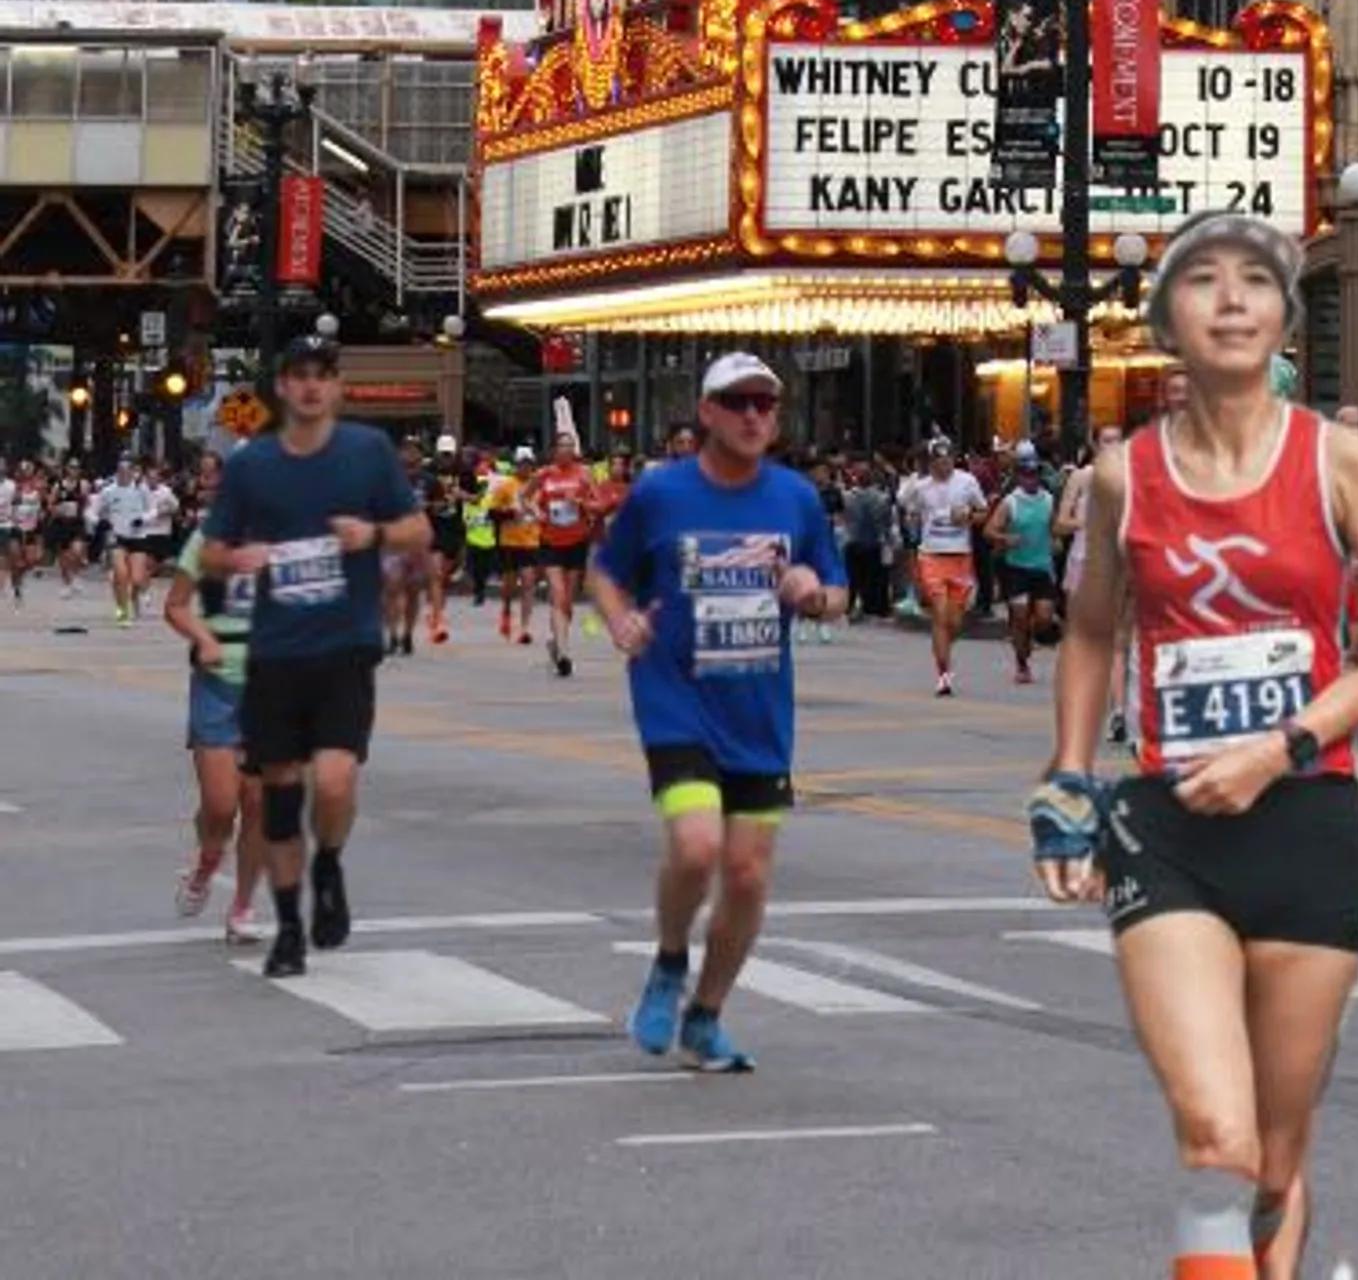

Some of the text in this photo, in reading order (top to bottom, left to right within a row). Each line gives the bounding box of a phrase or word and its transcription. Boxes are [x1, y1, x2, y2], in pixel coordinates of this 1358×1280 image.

[774, 57, 937, 96] WHITNEY
[796, 118, 918, 155] FELIPE
[1160, 122, 1224, 157] OCT
[1247, 124, 1280, 160] 19
[809, 176, 918, 211] KANY
[1226, 181, 1272, 216] 24
[1161, 674, 1305, 735] E 4191
